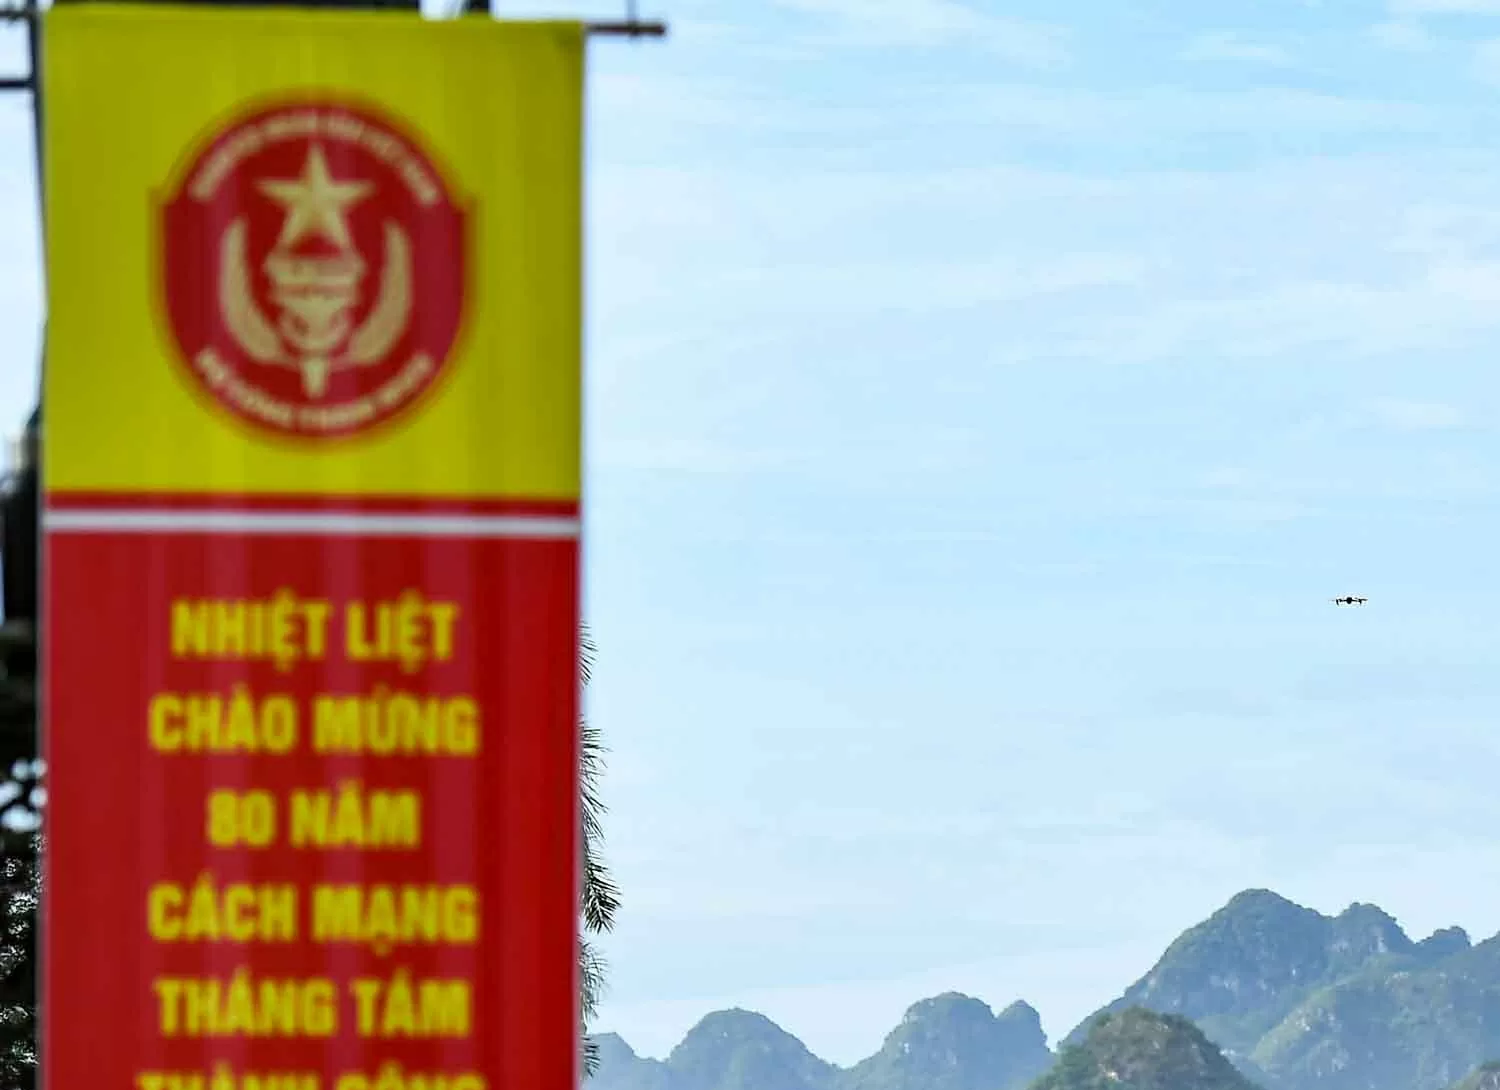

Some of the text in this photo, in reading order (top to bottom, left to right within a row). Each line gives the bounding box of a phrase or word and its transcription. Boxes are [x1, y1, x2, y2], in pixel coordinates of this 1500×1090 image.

[171, 590, 458, 672] NHIỆT LIỆT
[148, 684, 298, 753] CHÀO
[207, 779, 420, 848] 80 NĂM
[148, 872, 479, 956] CÁCH MẠNG
[153, 966, 471, 1037] THÁNG TÁM
